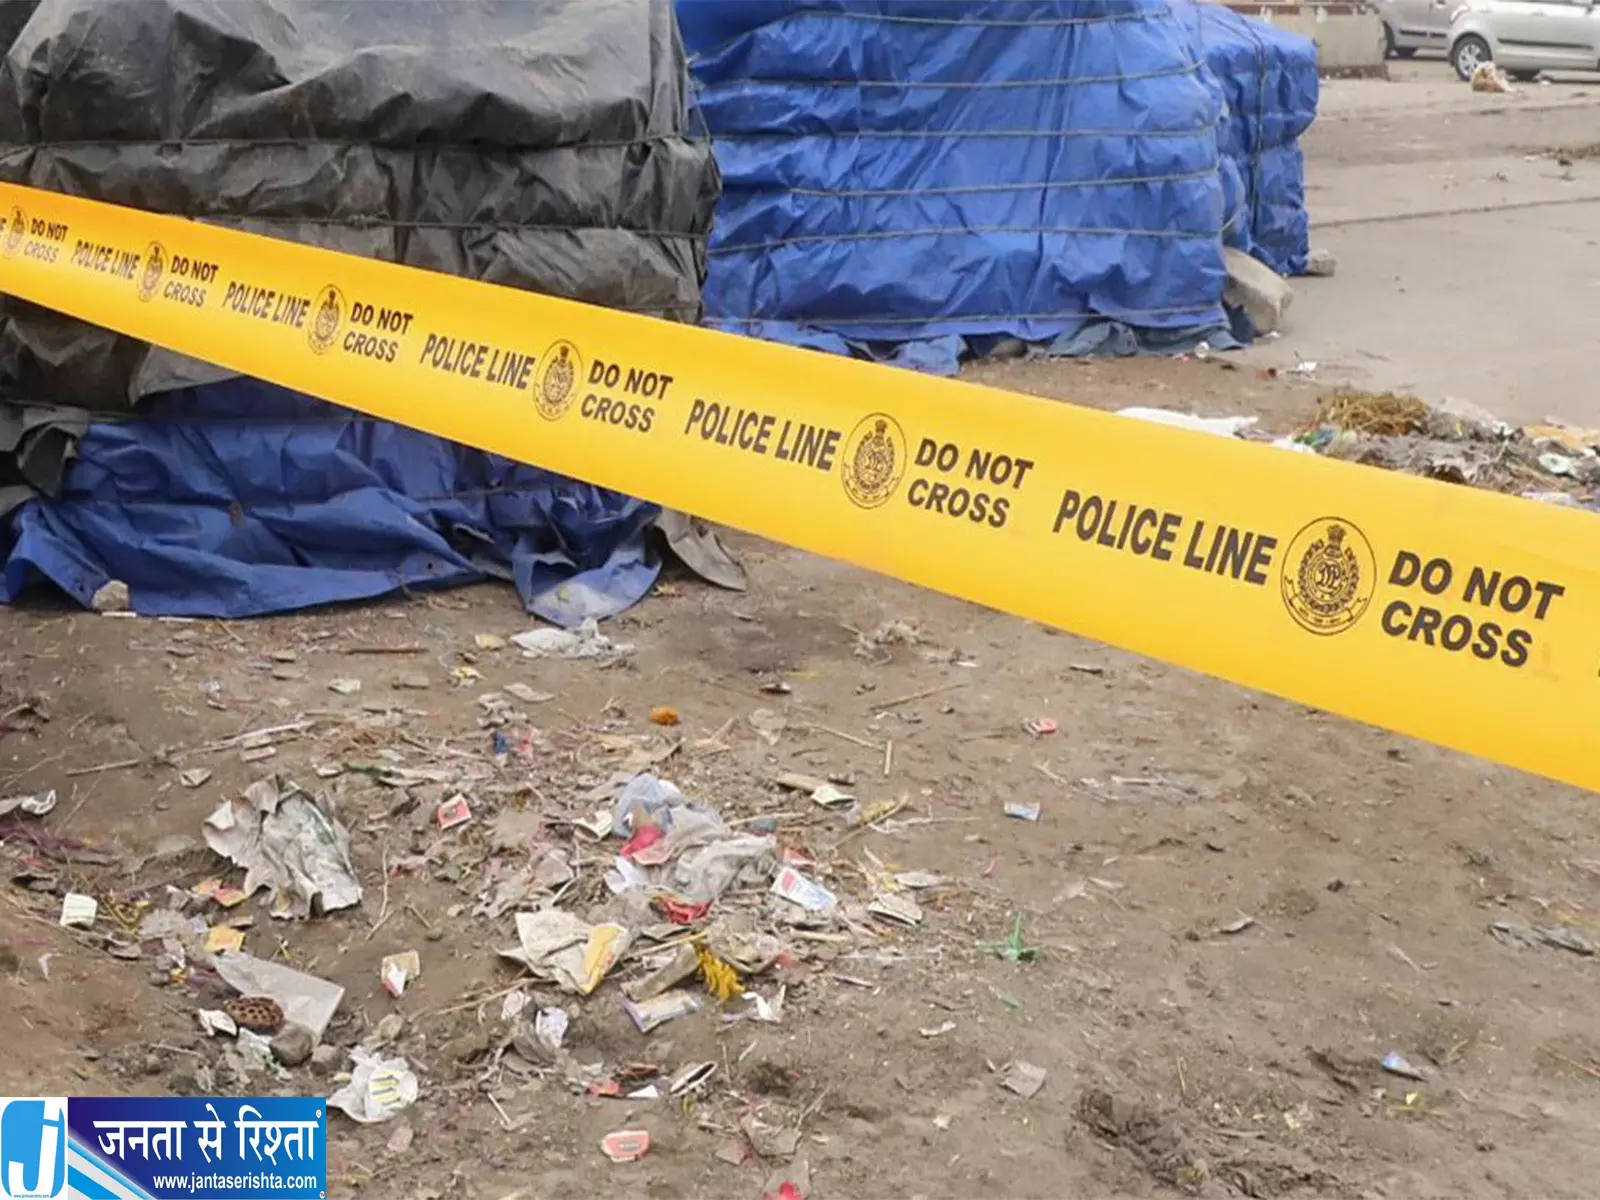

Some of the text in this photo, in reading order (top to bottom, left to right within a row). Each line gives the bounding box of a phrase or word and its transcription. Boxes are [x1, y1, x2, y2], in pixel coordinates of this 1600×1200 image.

[31, 217, 68, 242] DO NOT
[24, 240, 59, 263] CROSS
[71, 239, 140, 281] POLICE LINE
[170, 254, 219, 284] DO NOT
[163, 280, 207, 308] CROSS
[221, 280, 310, 328] POLICE LINE
[350, 301, 414, 335] DO NOT
[343, 330, 399, 363] CROSS
[419, 333, 536, 390] POLICE LINE
[587, 359, 674, 400] DO NOT
[580, 393, 655, 433] CROSS
[684, 398, 842, 472] POLICE LINE
[914, 437, 1034, 490] DO NOT
[907, 478, 1011, 529] CROSS
[1052, 489, 1278, 586] POLICE LINE
[1387, 549, 1566, 621] DO NOT
[1380, 599, 1533, 668] CROSS
